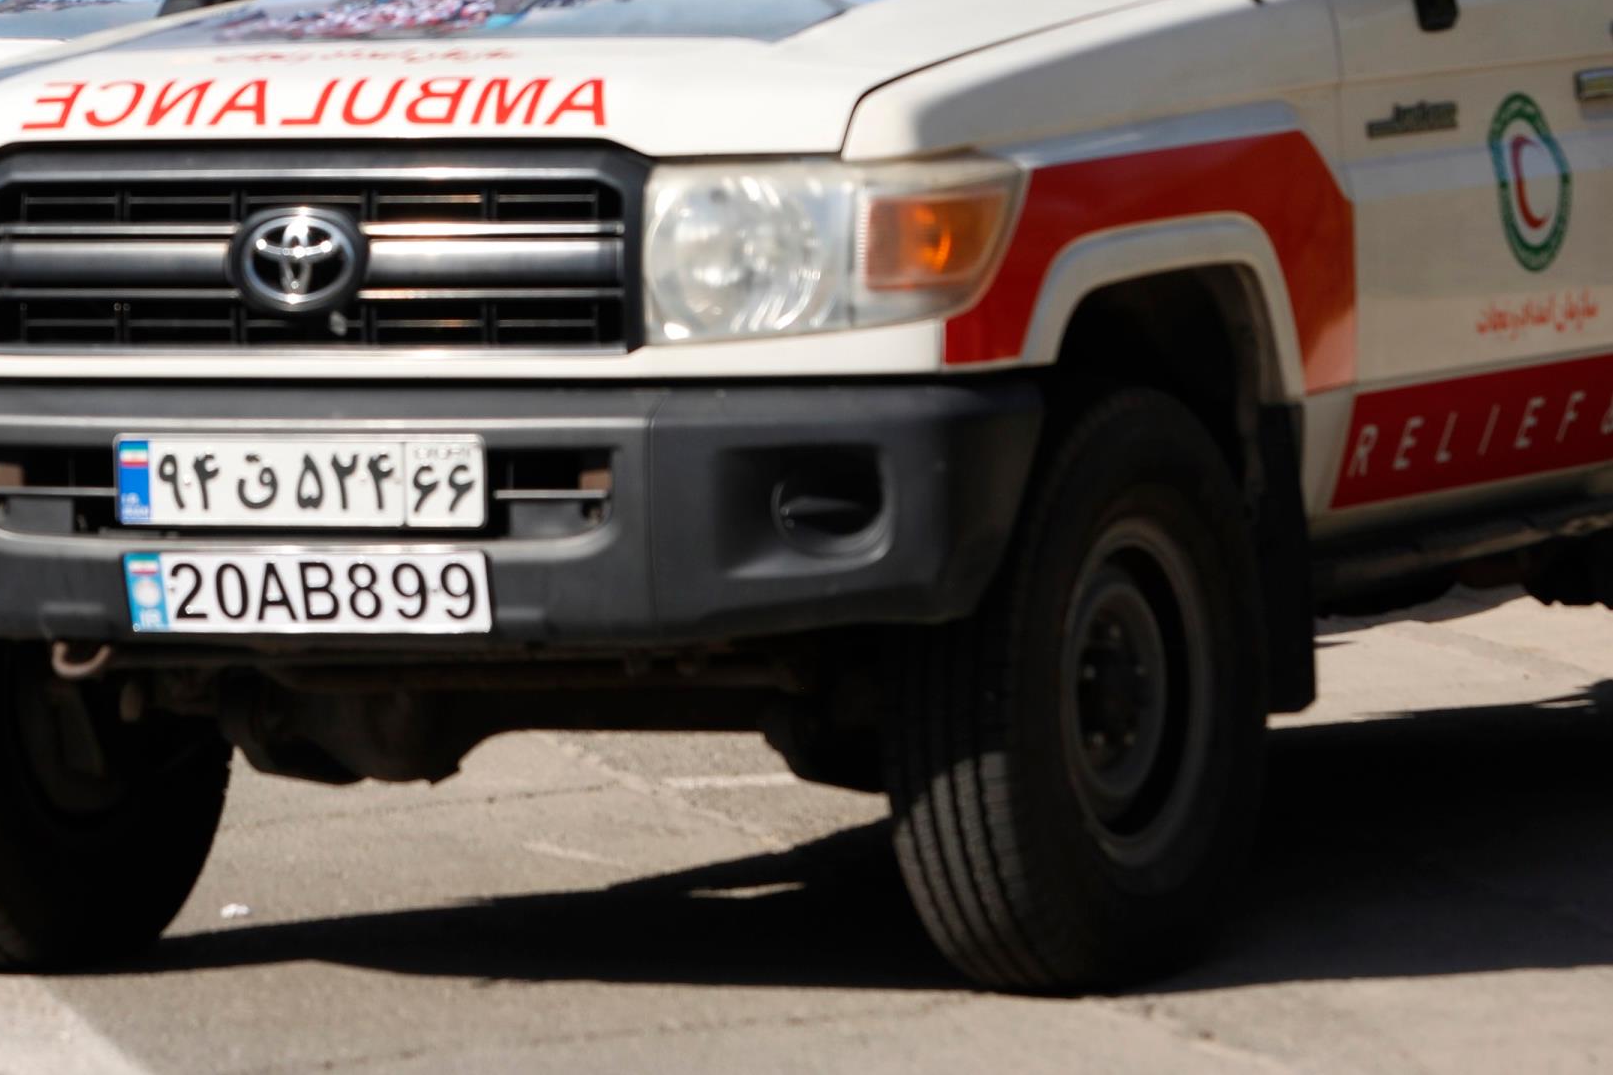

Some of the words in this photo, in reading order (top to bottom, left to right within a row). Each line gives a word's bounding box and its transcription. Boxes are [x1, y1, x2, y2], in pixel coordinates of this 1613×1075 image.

[157, 453, 220, 510] ۹۴
[236, 453, 279, 510] ق
[295, 453, 396, 511] ۵۲۴
[412, 464, 476, 513] ۶۶
[169, 562, 478, 622] 20AB899
